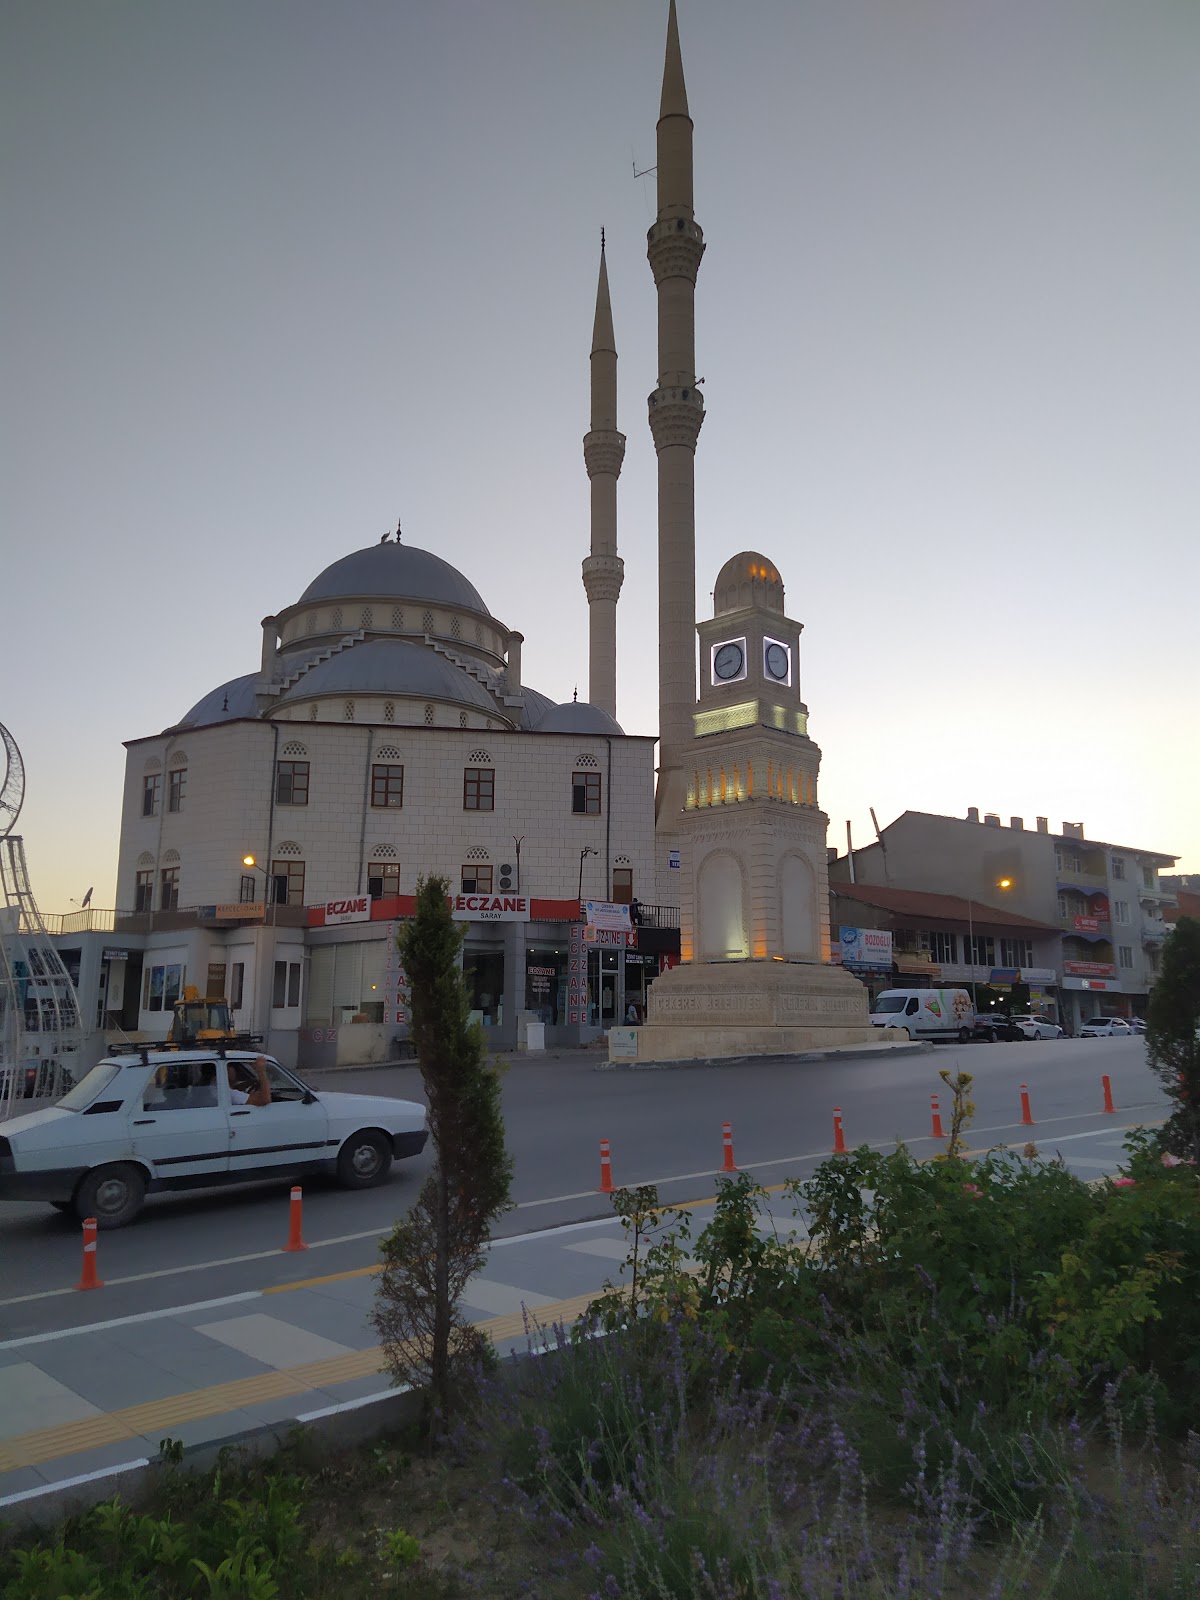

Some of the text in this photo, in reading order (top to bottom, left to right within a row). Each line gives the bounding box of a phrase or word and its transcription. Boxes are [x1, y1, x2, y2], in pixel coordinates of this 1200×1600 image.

[327, 898, 367, 915] ECZANE
[456, 897, 526, 911] ECZANE
[865, 933, 891, 947] BOZOĞLU
[657, 996, 702, 1011] ÇEKEREK
